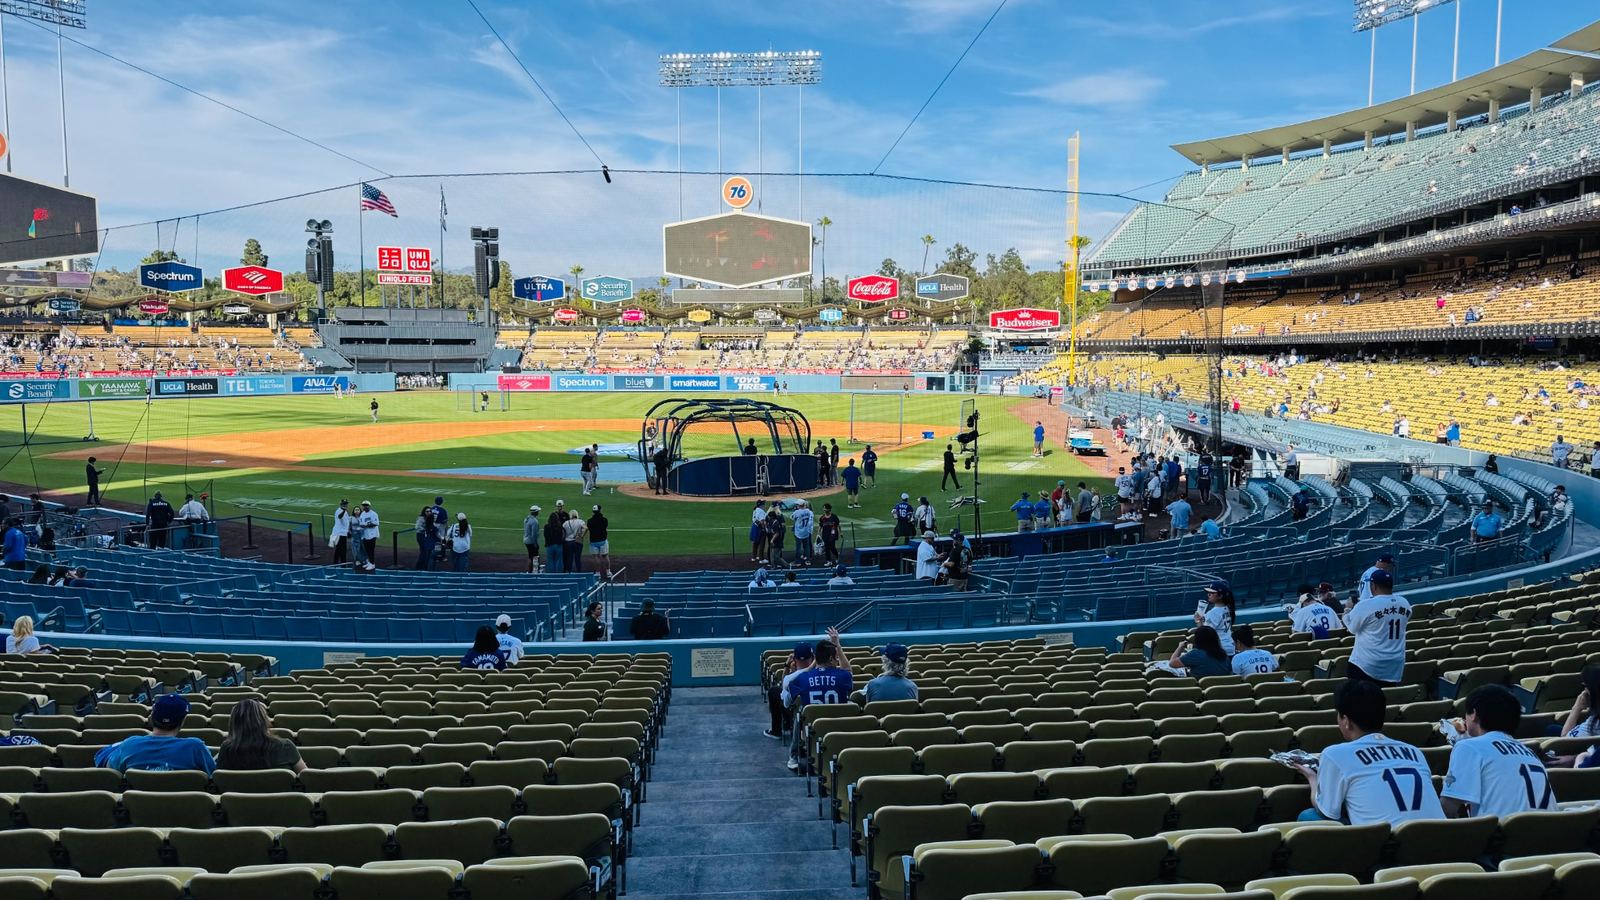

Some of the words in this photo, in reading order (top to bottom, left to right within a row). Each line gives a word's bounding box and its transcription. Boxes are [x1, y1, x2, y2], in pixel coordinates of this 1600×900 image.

[730, 185, 747, 199] 76
[409, 251, 427, 259] UNI
[410, 260, 428, 269] QLO
[147, 270, 194, 281] Spectrum
[600, 282, 628, 291] Security
[852, 281, 893, 296] Coca-Cola
[920, 283, 938, 292] UCLA
[940, 283, 964, 291] Health
[600, 289, 625, 297] Benefit
[823, 309, 840, 319] TEL
[997, 317, 1053, 327] Budweiser
[303, 378, 326, 387] ANA
[559, 378, 601, 388] Spectrum
[625, 378, 645, 386] blue
[672, 379, 718, 387] smartwater
[733, 376, 761, 384] TOYO
[26, 382, 56, 391] Security
[186, 382, 213, 391] Health
[226, 380, 255, 392] TEL
[737, 383, 769, 391] TIRES
[27, 390, 53, 398] Benefit
[1321, 616, 1330, 629] 8
[1388, 618, 1401, 640] 11
[809, 675, 836, 687] BETTS
[809, 689, 839, 704] 50
[1492, 740, 1541, 758] OHTA
[1355, 745, 1419, 766] OHTANI
[1382, 767, 1423, 812] 17
[1519, 763, 1552, 810] 17
